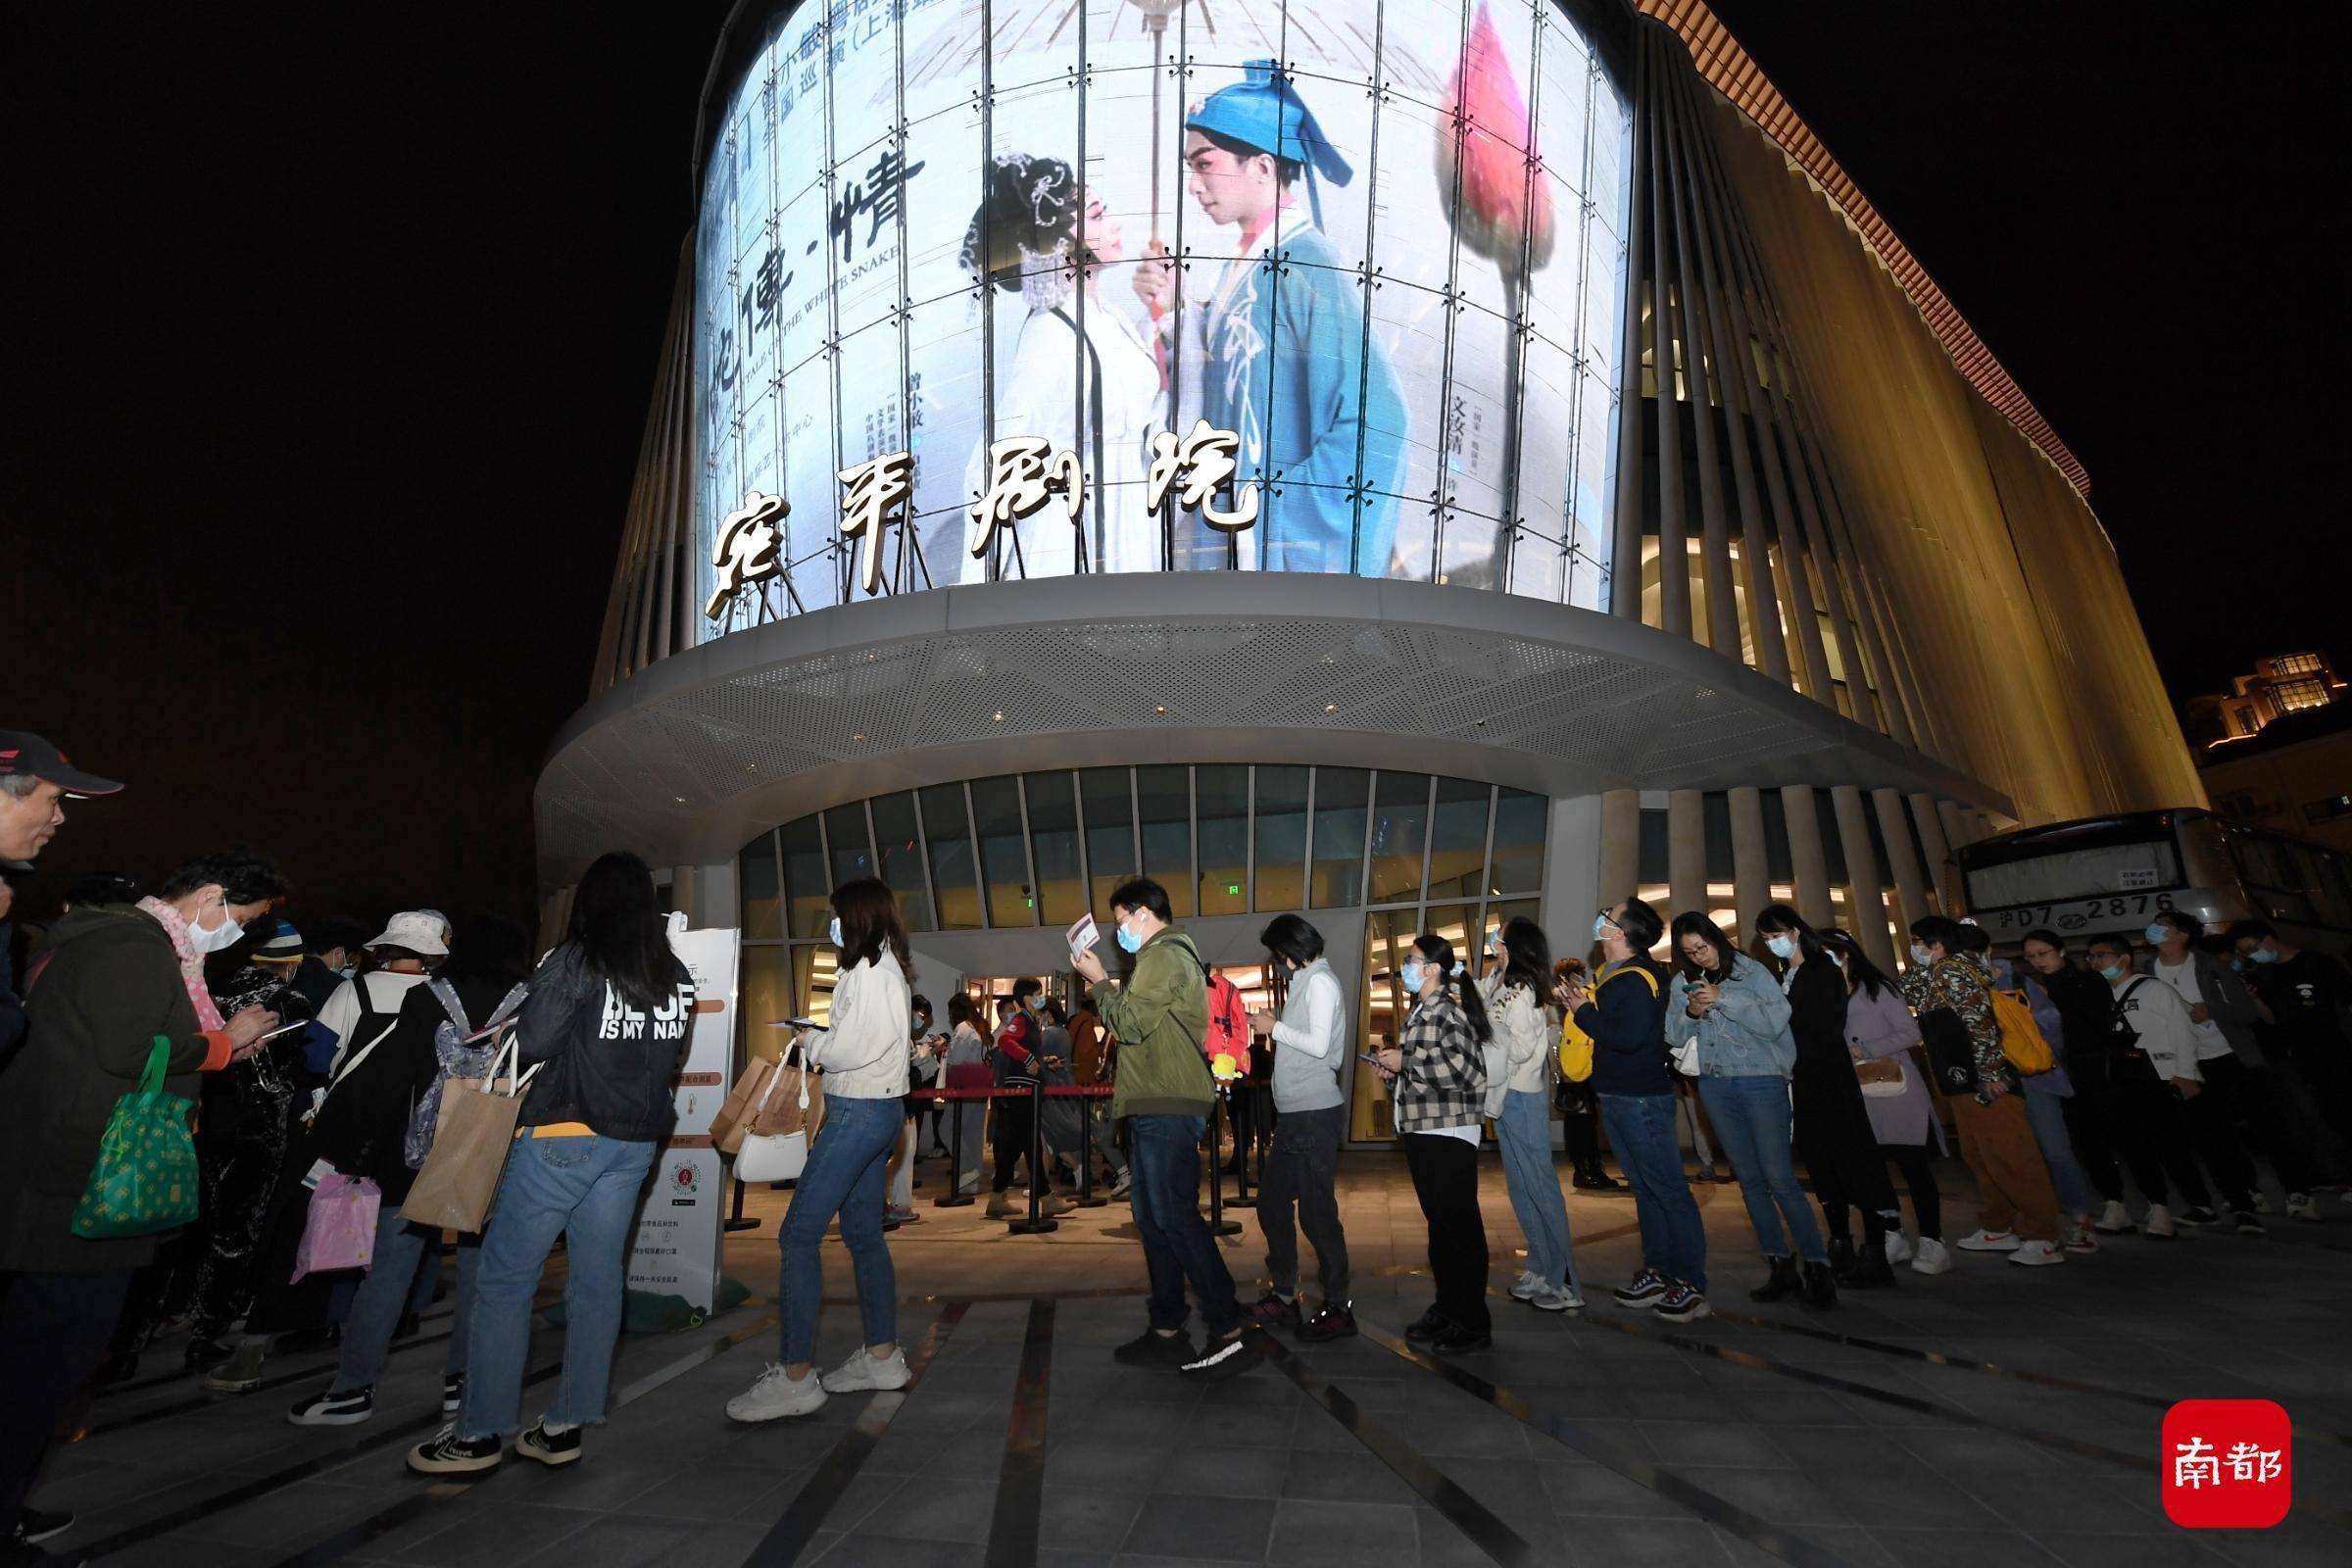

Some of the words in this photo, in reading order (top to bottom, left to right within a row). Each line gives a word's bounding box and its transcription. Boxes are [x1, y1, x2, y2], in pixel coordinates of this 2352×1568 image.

[783, 310, 803, 336] THE
[805, 275, 849, 315] WHITE
[851, 244, 899, 282] SNAKE
[2086, 893, 2174, 919] 2876
[599, 1020, 619, 1040] IS
[622, 1020, 645, 1040] MY
